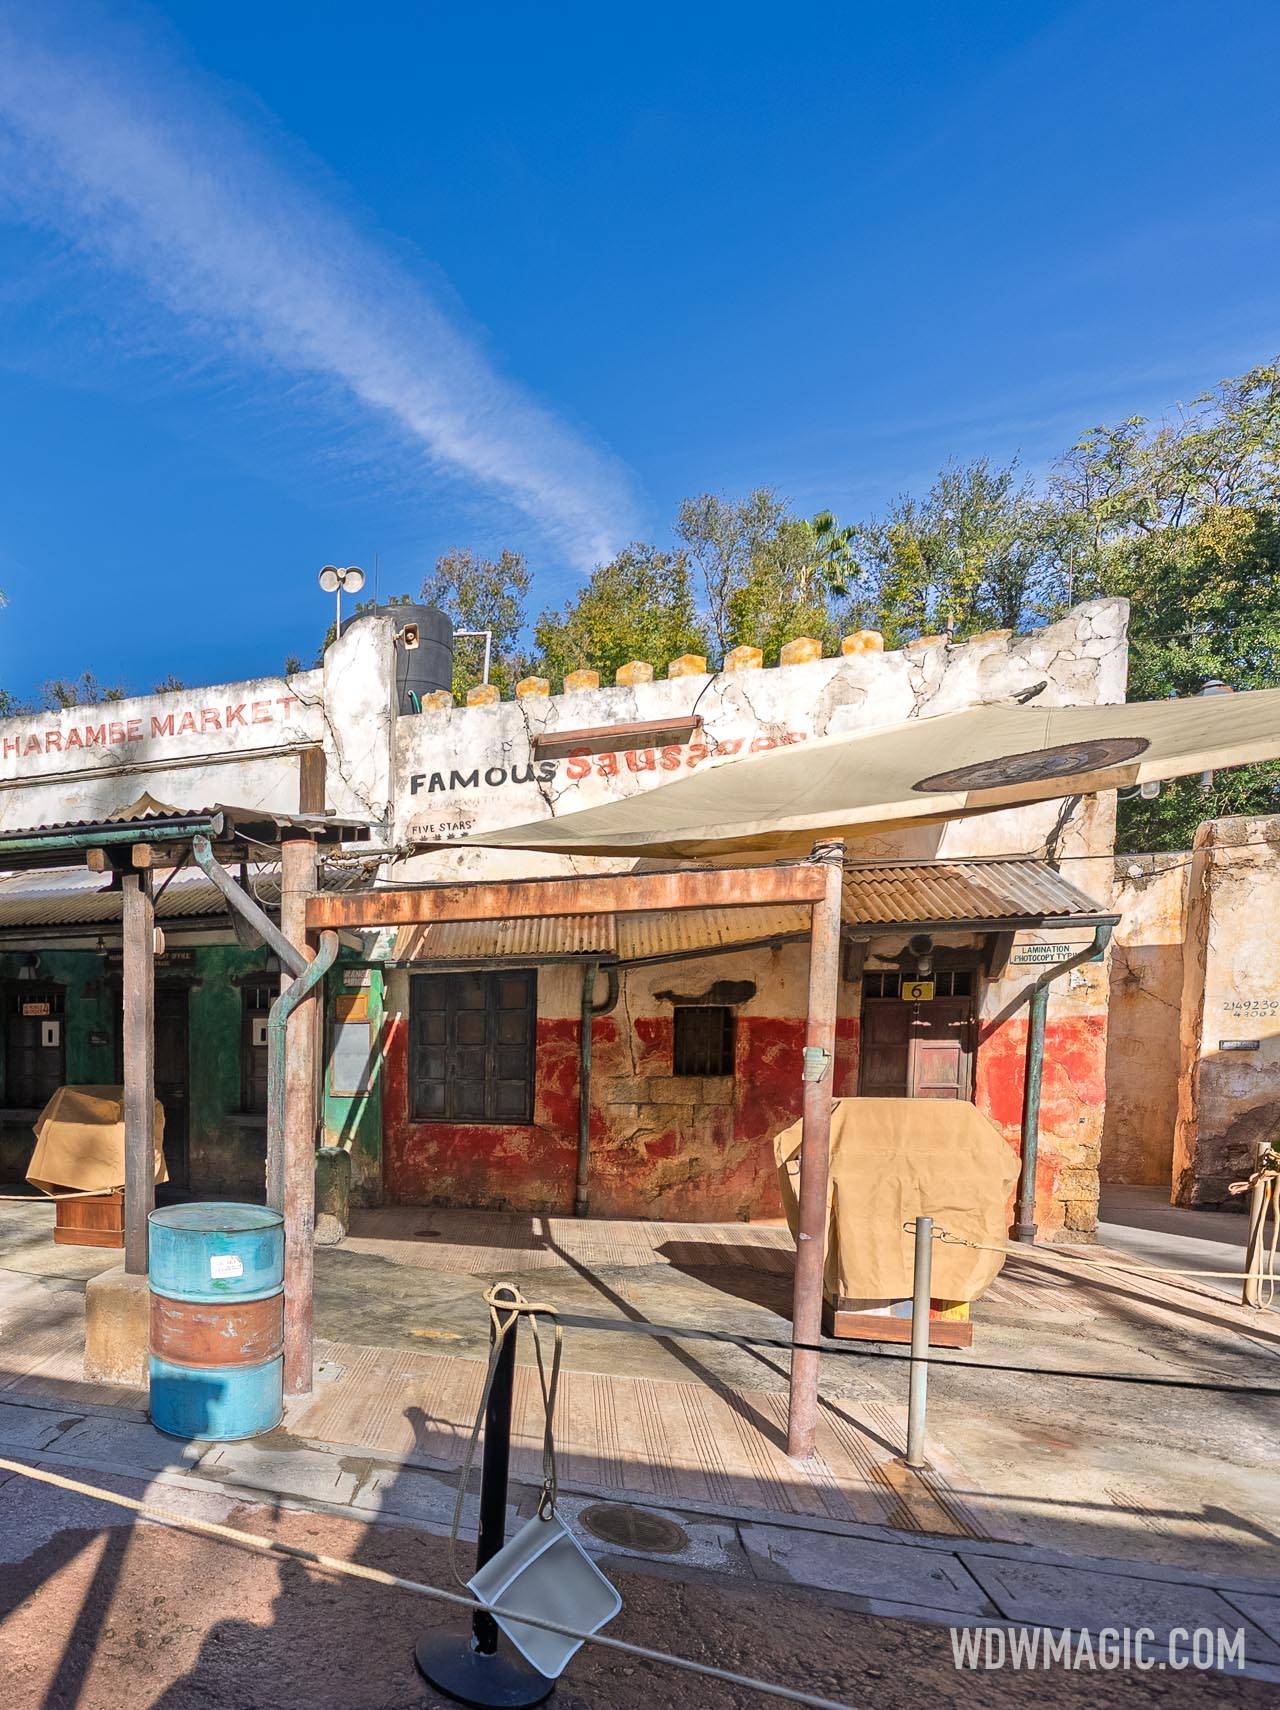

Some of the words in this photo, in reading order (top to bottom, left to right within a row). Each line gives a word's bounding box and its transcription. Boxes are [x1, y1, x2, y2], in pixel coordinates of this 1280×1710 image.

[3, 719, 143, 759] HARAMBE
[150, 697, 298, 738] MARKET
[410, 762, 558, 795] FAMOUS
[412, 825, 435, 834] FIVE
[1022, 945, 1070, 954] LAMINATION
[1014, 953, 1055, 962] PHOTOCOPY
[911, 983, 922, 998] 6
